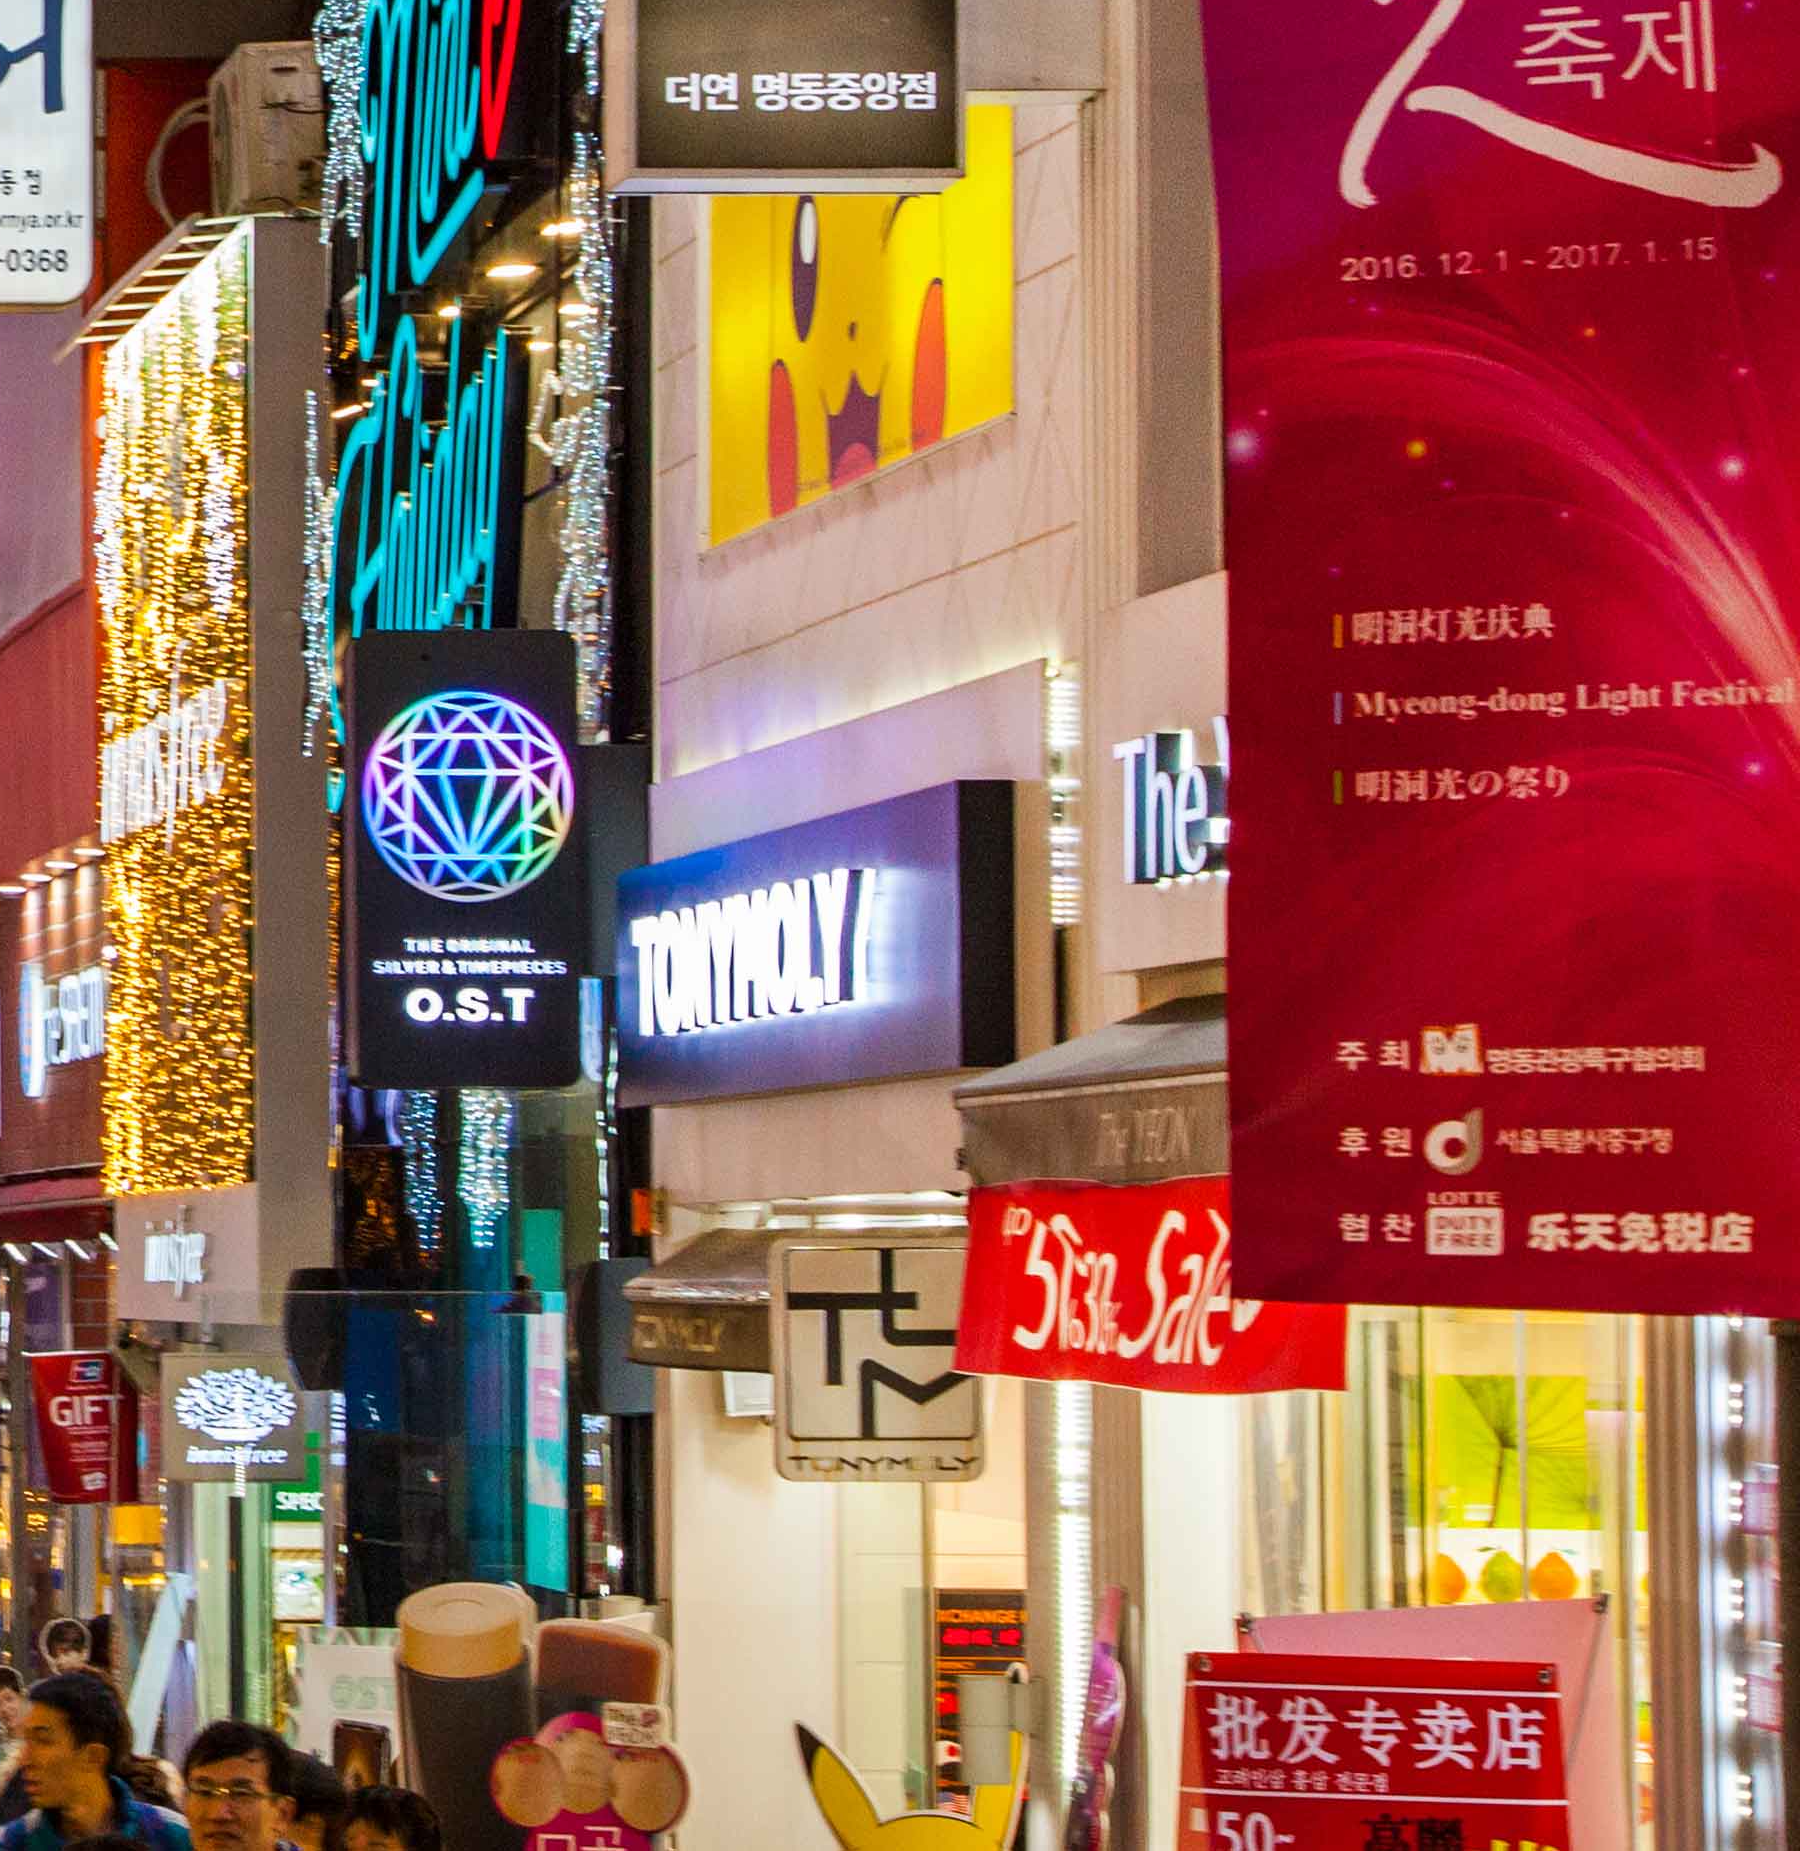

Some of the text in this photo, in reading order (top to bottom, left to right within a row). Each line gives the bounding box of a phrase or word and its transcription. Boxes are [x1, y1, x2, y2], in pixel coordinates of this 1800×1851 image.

[665, 70, 937, 112] 더연 명동중앙점
[1340, 254, 1427, 284] 2016.
[1682, 235, 1719, 263] 15
[1354, 686, 1568, 721] Myeong-dong
[1576, 683, 1662, 717] Light
[1354, 764, 1571, 803] 明洞光の祭り
[631, 868, 877, 1036] TONYMOLY
[405, 987, 536, 1023] O.S.T
[1426, 1191, 1503, 1206] LOTTE
[1526, 1213, 1754, 1253] 乐天免税店
[1206, 1692, 1546, 1771] 批发专卖店
